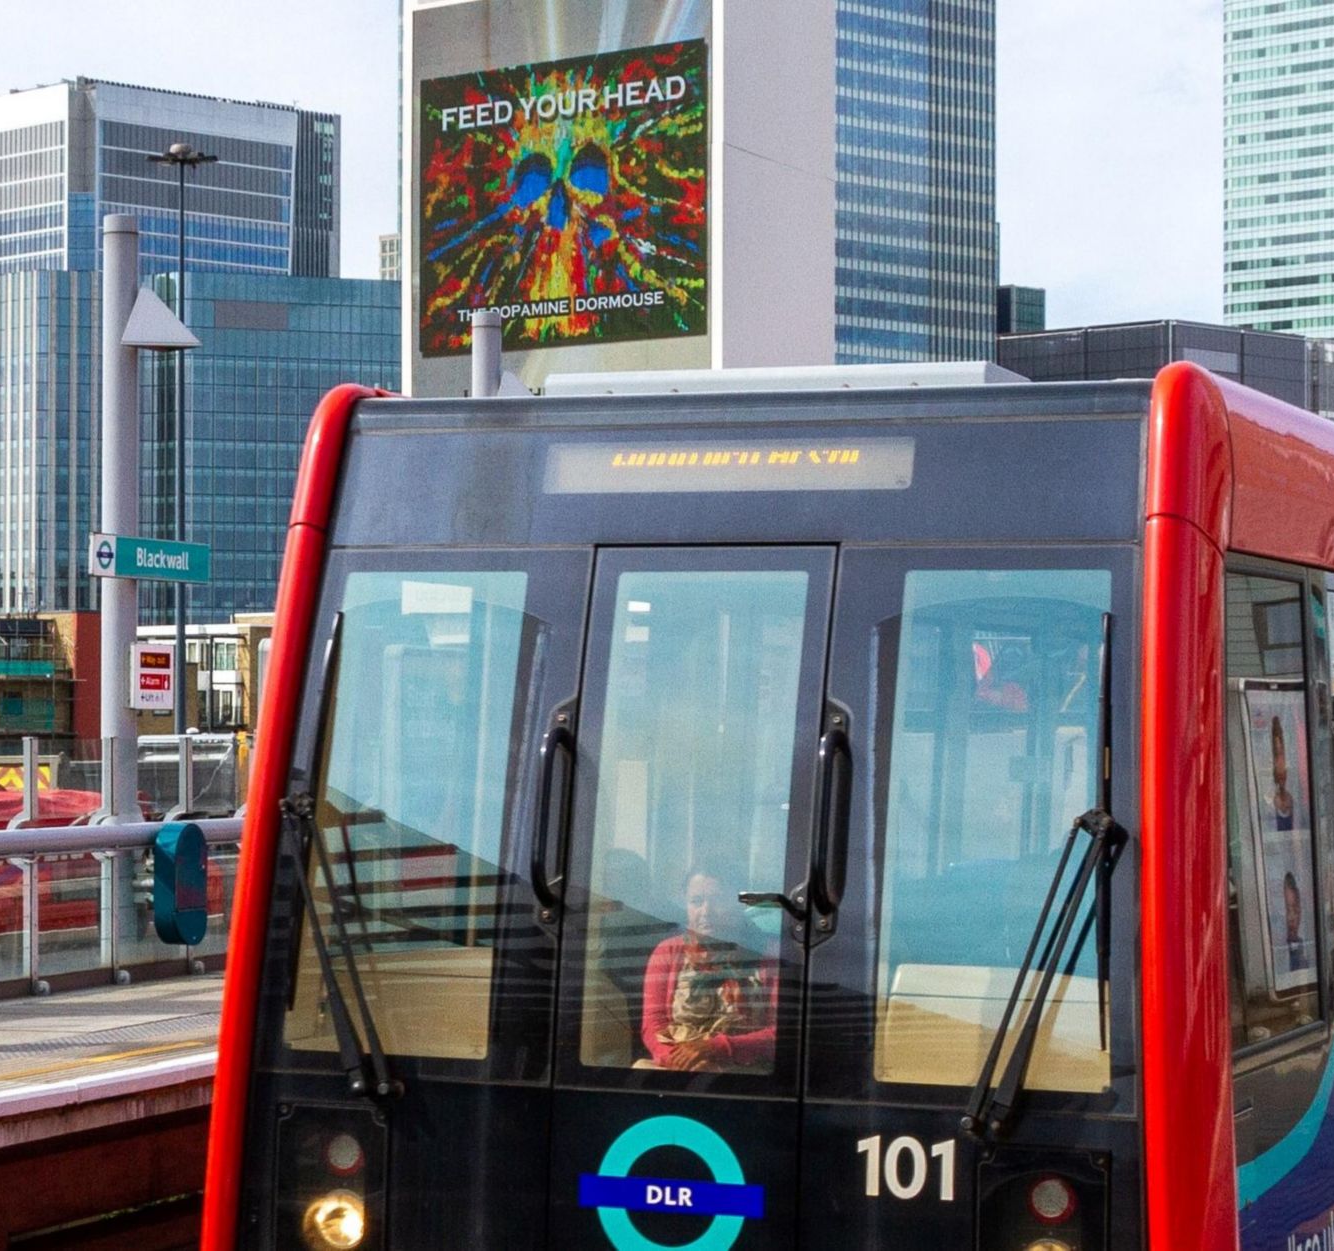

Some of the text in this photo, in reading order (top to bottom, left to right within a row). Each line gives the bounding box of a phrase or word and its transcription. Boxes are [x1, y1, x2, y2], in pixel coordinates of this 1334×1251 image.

[442, 75, 687, 132] FEED YOUR HEAD
[457, 307, 486, 322] TH
[575, 290, 665, 312] DORMOUSE
[135, 547, 190, 571] Blackwall
[857, 1134, 956, 1202] 101
[645, 1184, 694, 1207] DLR
